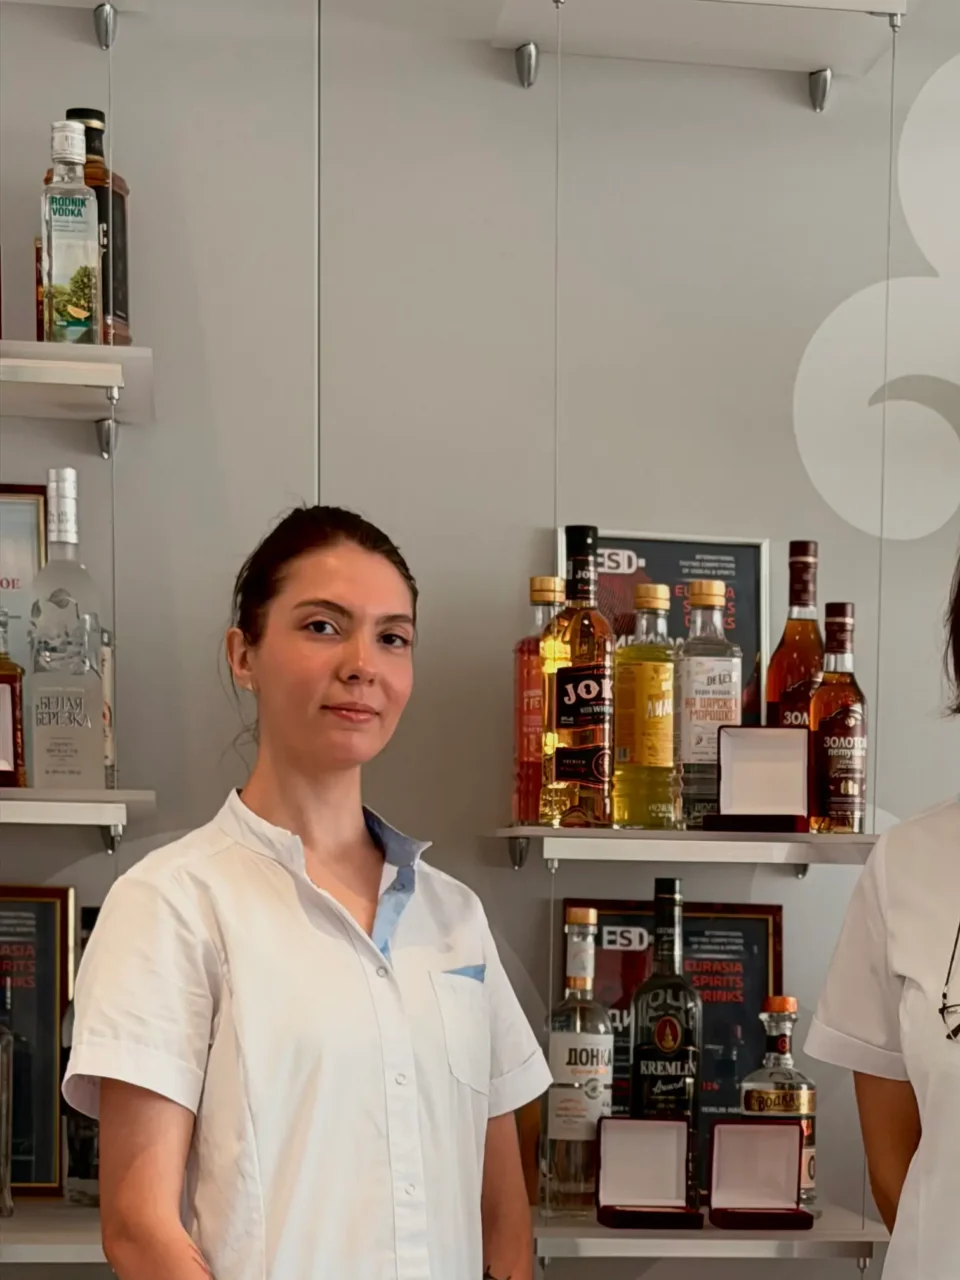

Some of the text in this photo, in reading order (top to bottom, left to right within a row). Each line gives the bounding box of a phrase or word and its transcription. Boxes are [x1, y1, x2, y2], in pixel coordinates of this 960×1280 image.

[51, 196, 87, 208] RODNIK
[53, 207, 83, 218] VODKA
[684, 960, 744, 973] EURASIA
[692, 976, 744, 988] SPIRITS
